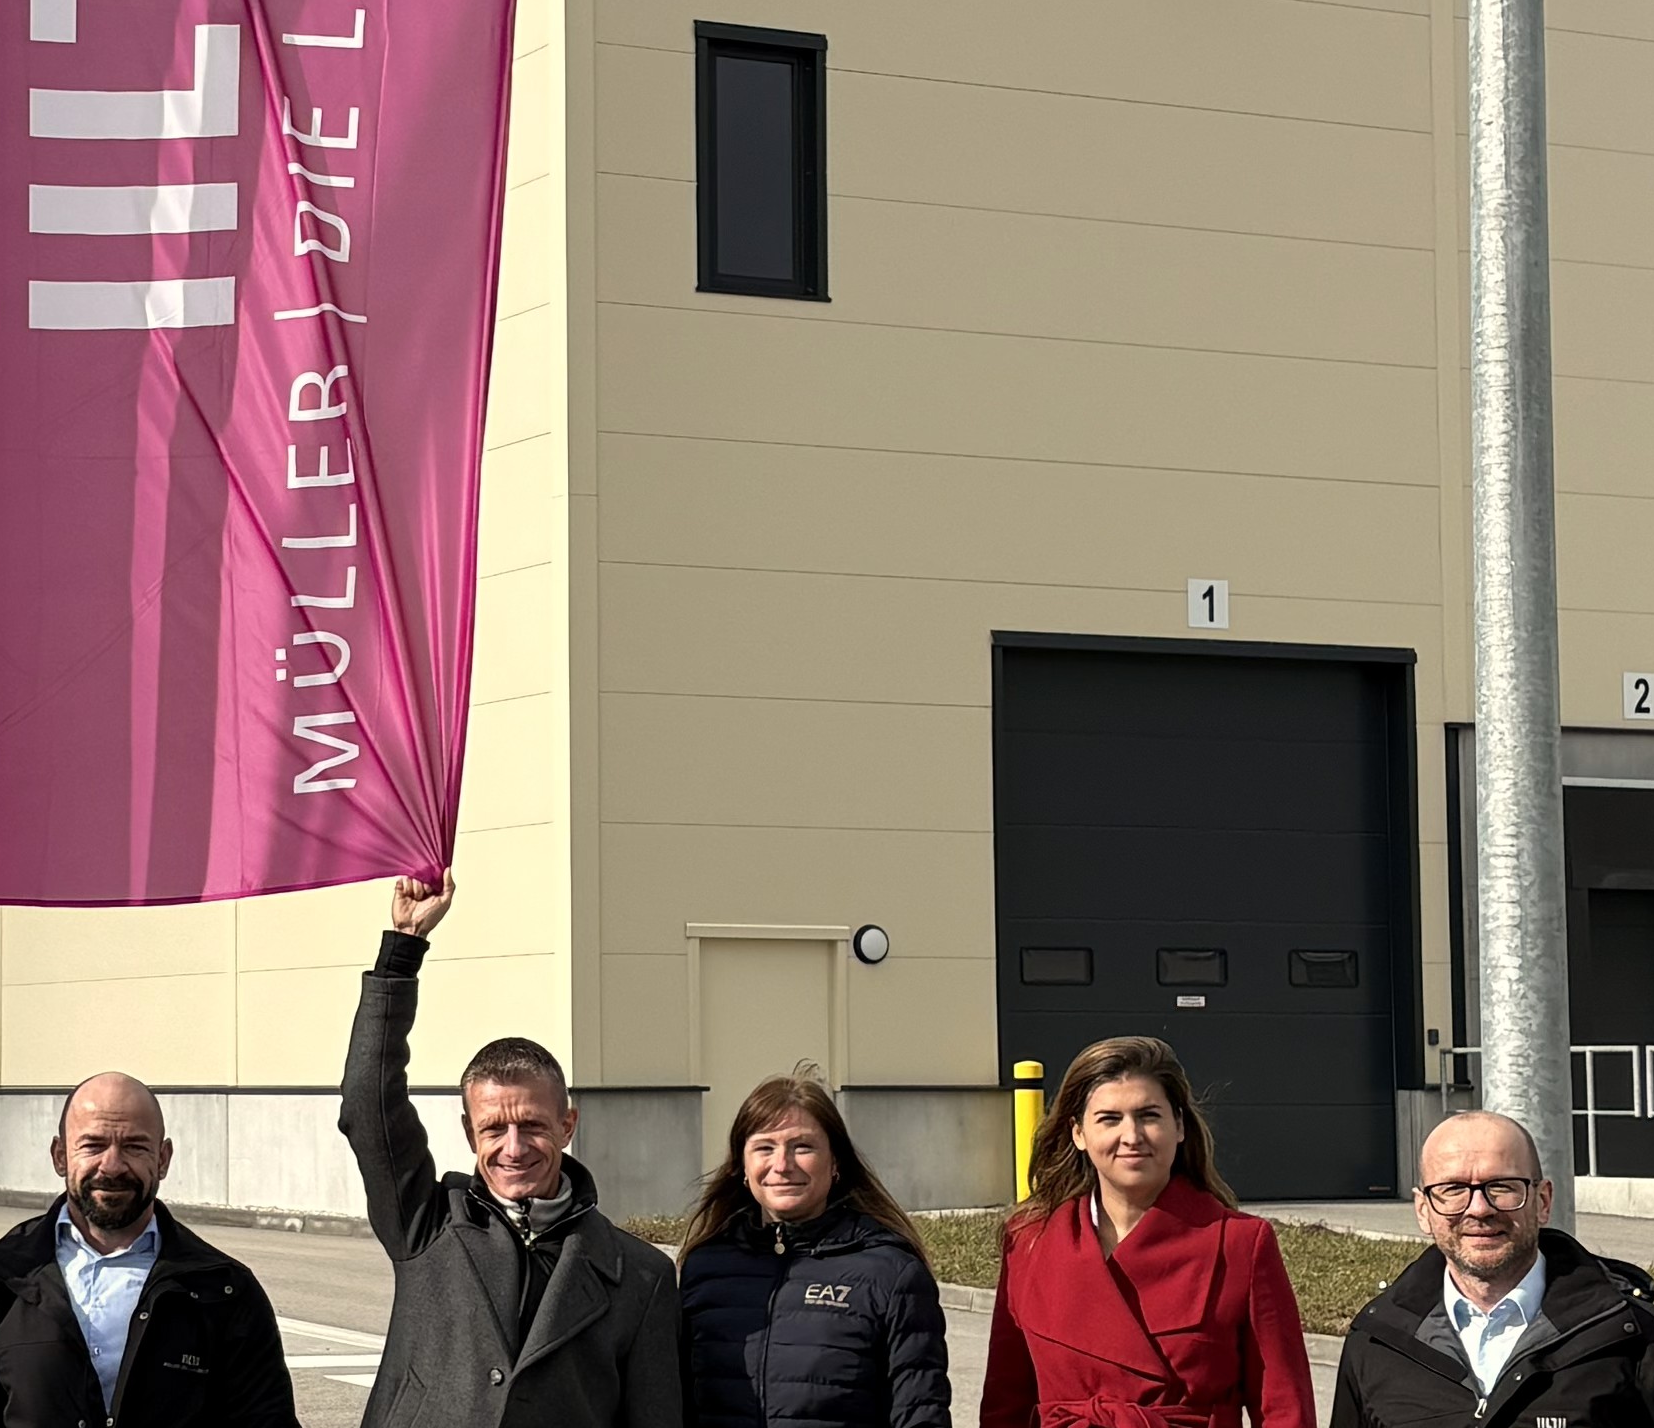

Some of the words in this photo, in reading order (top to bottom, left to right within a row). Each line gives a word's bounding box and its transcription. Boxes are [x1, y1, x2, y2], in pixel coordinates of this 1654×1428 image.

[282, 94, 361, 264] DIE
[275, 363, 361, 797] MÜLLER
[1202, 585, 1215, 623] 1
[1634, 678, 1651, 714] 2
[805, 1283, 852, 1302] EA7
